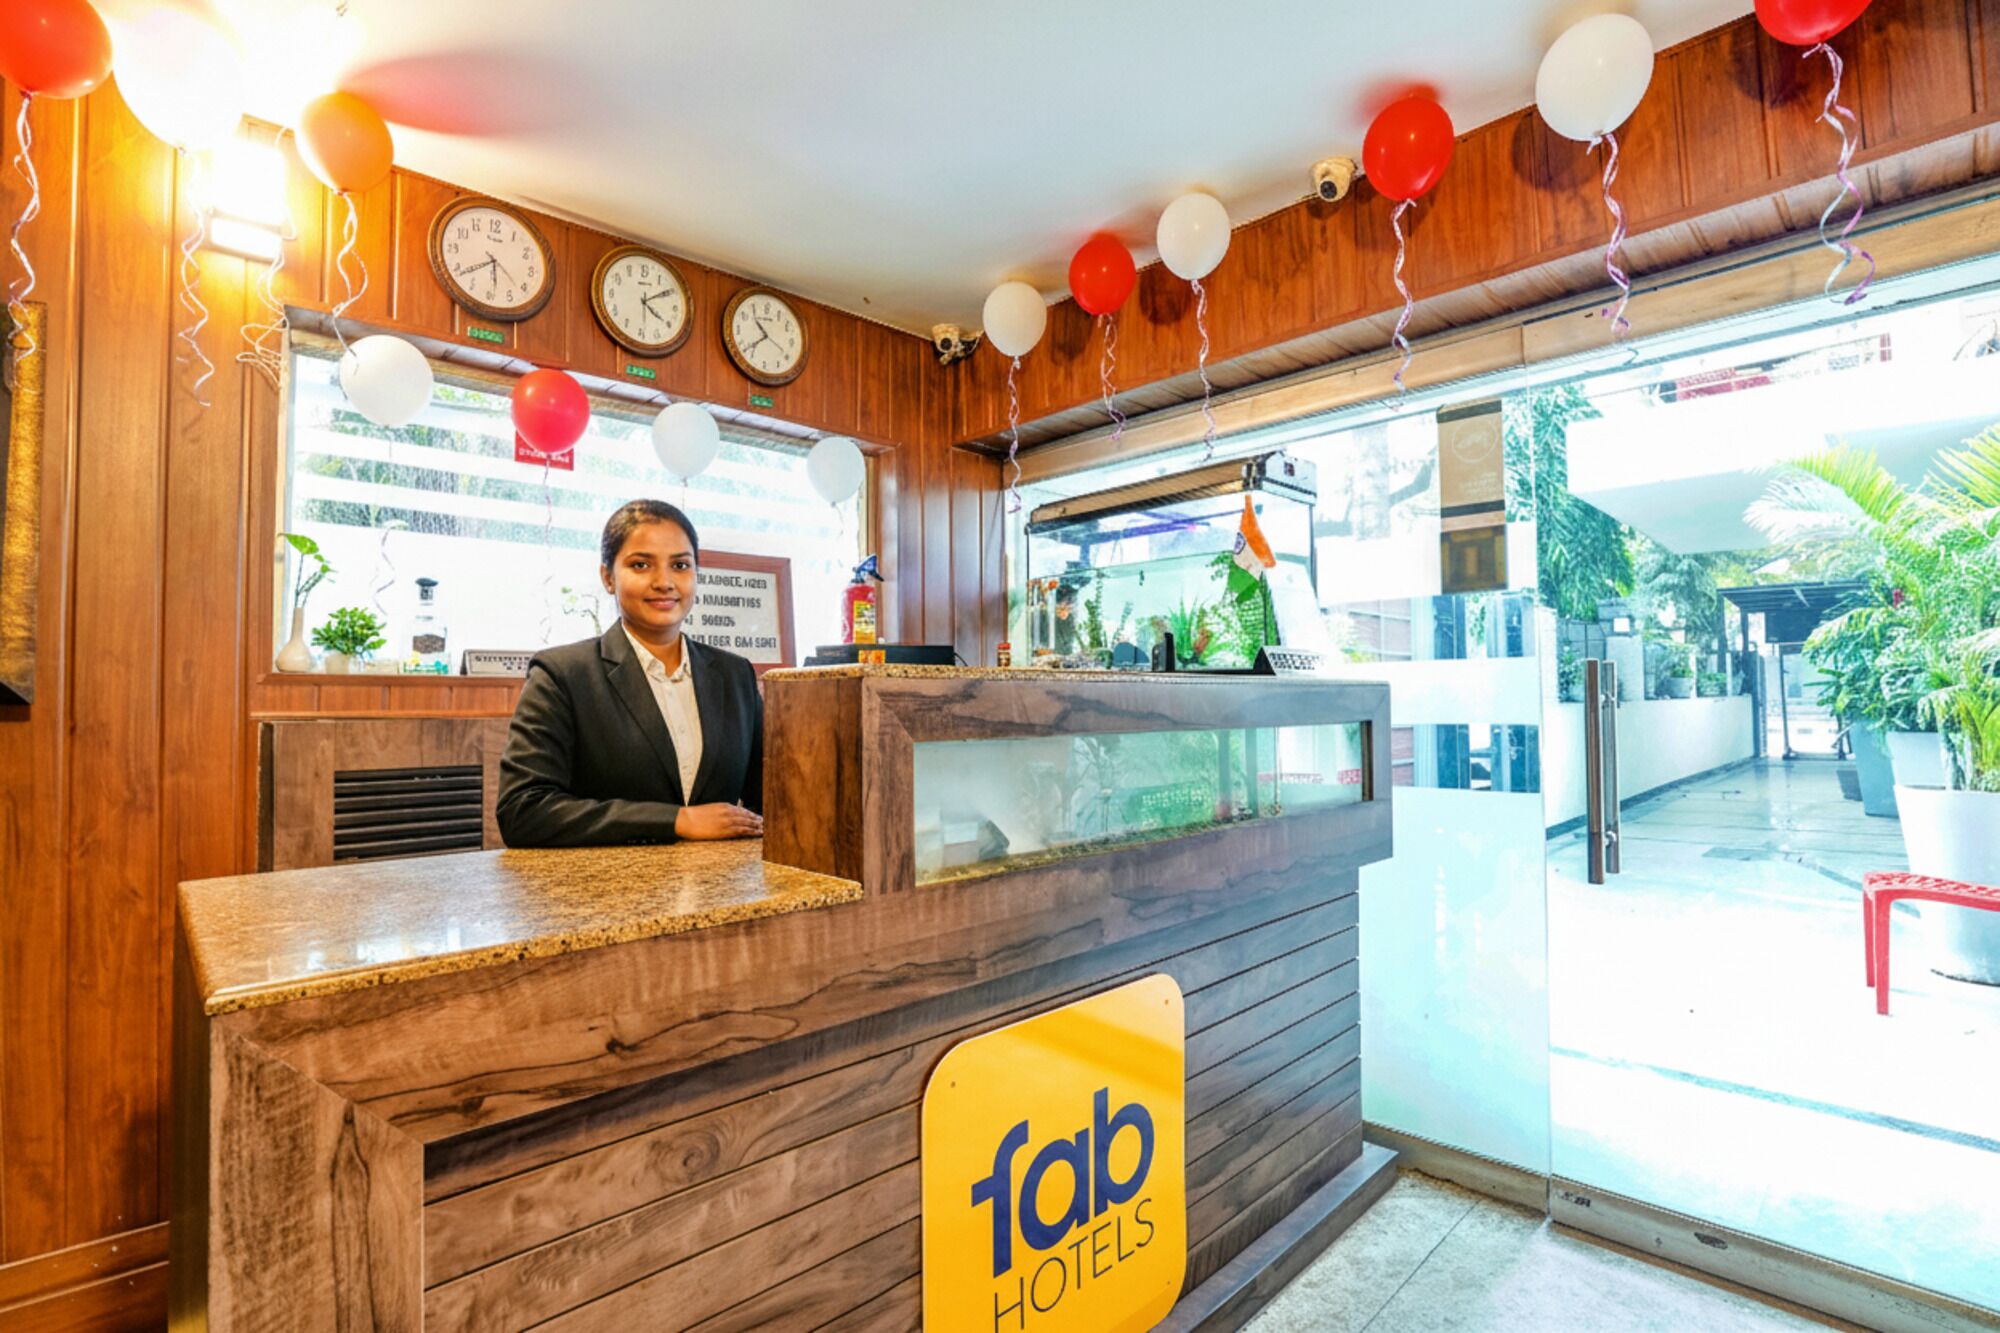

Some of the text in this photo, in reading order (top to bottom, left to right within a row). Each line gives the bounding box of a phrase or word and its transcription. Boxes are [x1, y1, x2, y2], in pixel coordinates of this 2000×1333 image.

[489, 218, 502, 234] 12
[971, 1086, 1155, 1279] fab
[994, 1197, 1155, 1333] HOTELS
